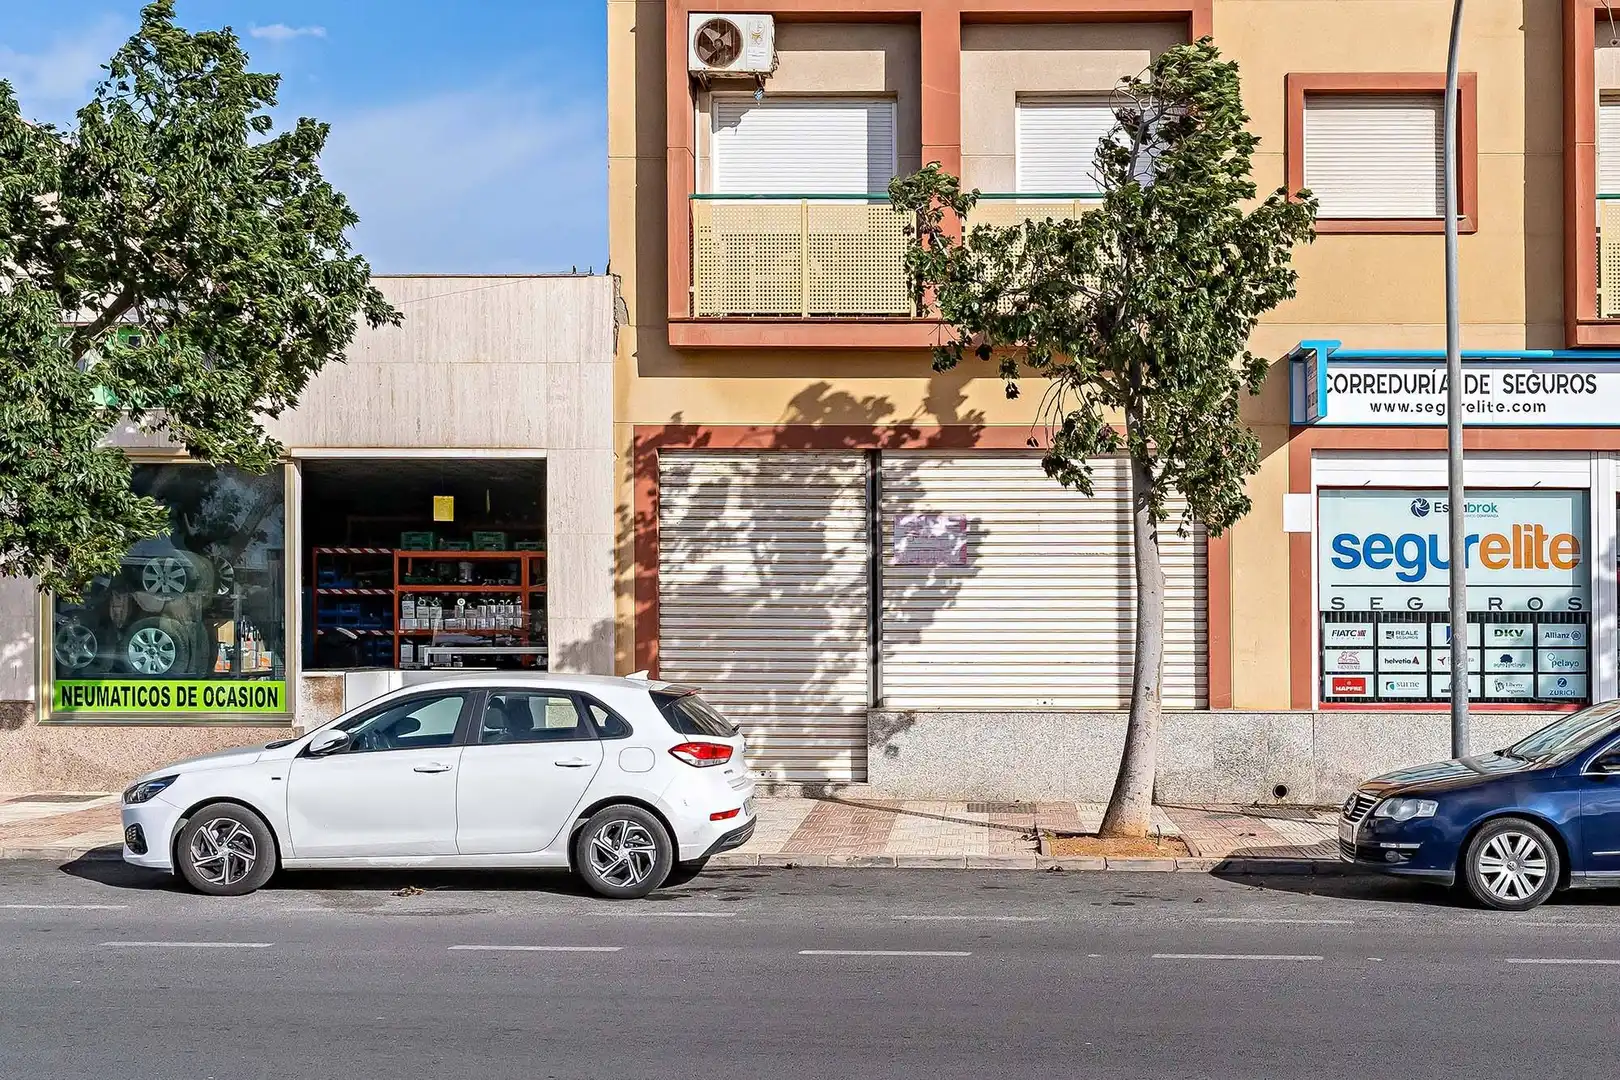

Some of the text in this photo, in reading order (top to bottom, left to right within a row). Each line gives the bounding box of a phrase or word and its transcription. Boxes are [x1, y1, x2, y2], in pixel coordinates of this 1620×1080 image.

[1464, 374, 1490, 395] DE
[1502, 373, 1597, 395] SEGUROS
[1370, 399, 1547, 416] www.segelite.com
[1434, 502, 1498, 513] Esbrok
[1330, 597, 1583, 611] SEGROS
[1494, 629, 1524, 637] DKV
[1544, 631, 1570, 639] Allianz
[1384, 657, 1412, 665] helvetia
[1551, 659, 1580, 668] pelayo
[61, 685, 278, 708] NEUMATICOS DE OCASION
